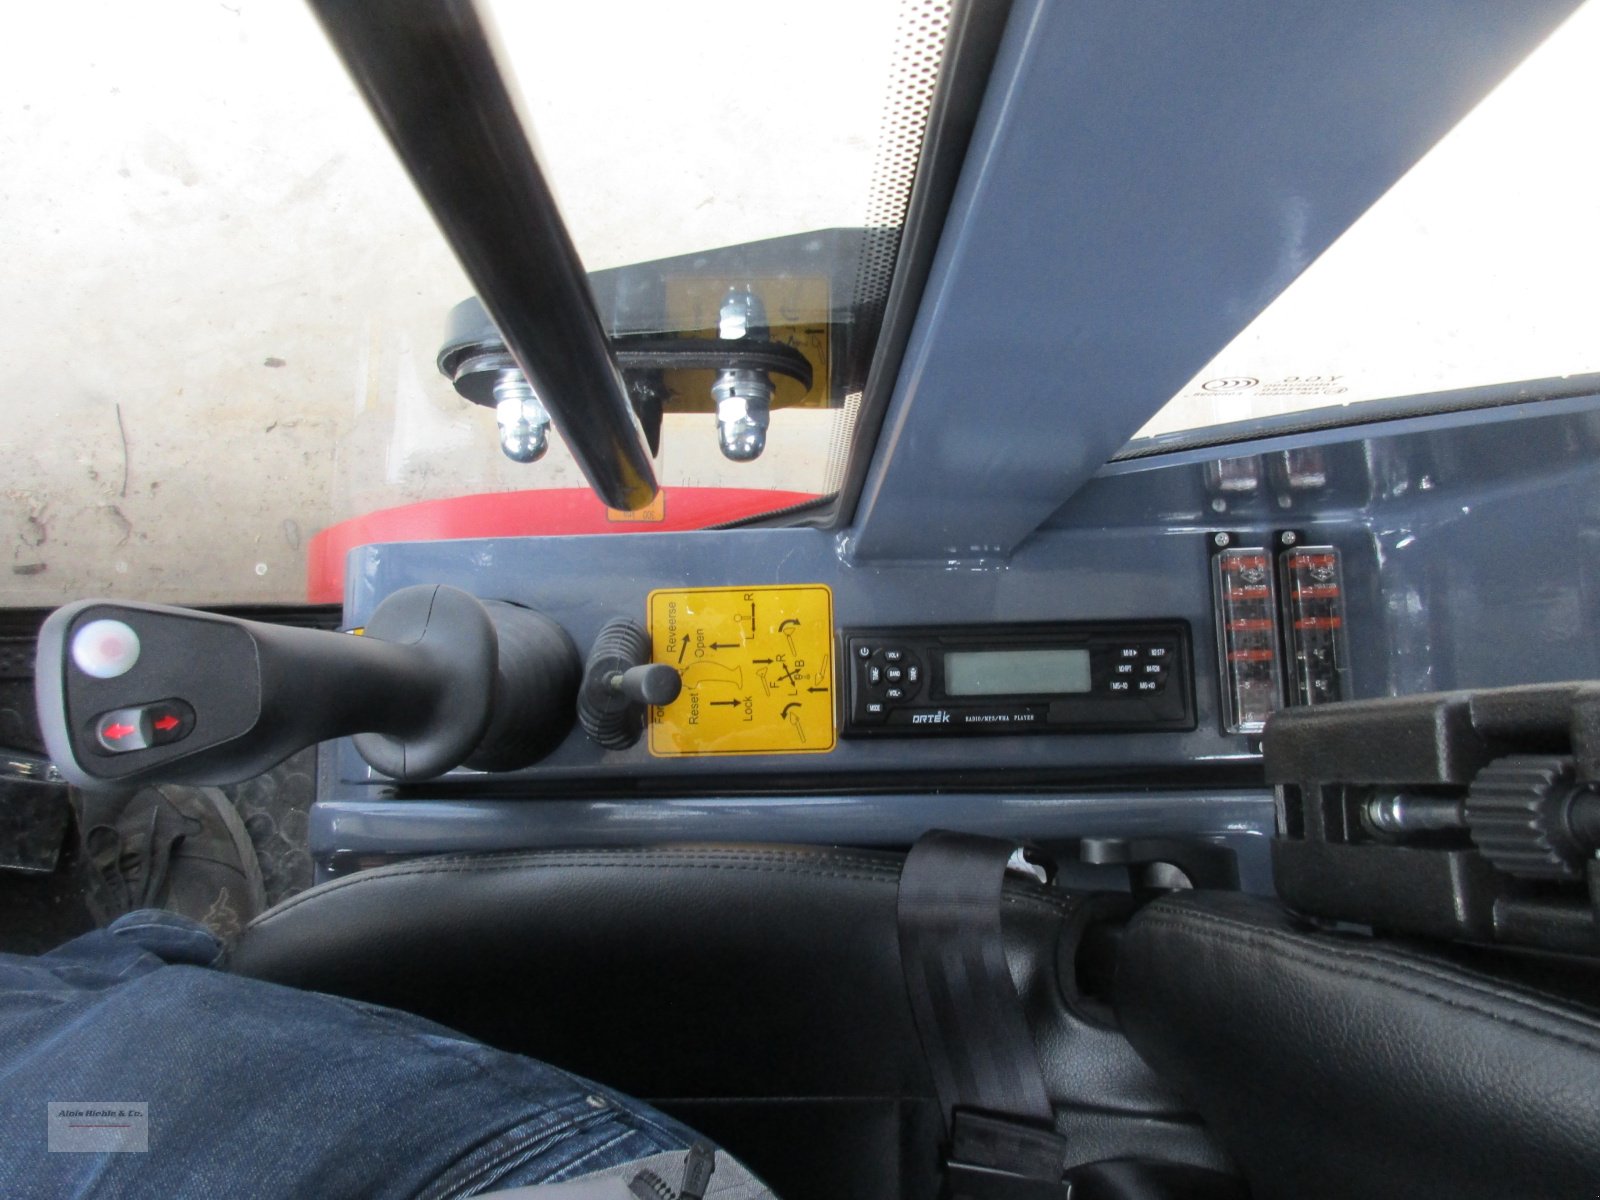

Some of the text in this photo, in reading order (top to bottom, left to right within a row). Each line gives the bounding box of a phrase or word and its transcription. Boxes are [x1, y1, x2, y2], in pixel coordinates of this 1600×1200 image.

[743, 593, 753, 601] R
[666, 601, 677, 653] Reveerse
[694, 628, 706, 659] Open
[776, 653, 785, 662] R
[795, 659, 805, 667] B
[688, 693, 699, 725] Reset
[743, 696, 753, 722] Lock
[869, 704, 881, 712] MODE
